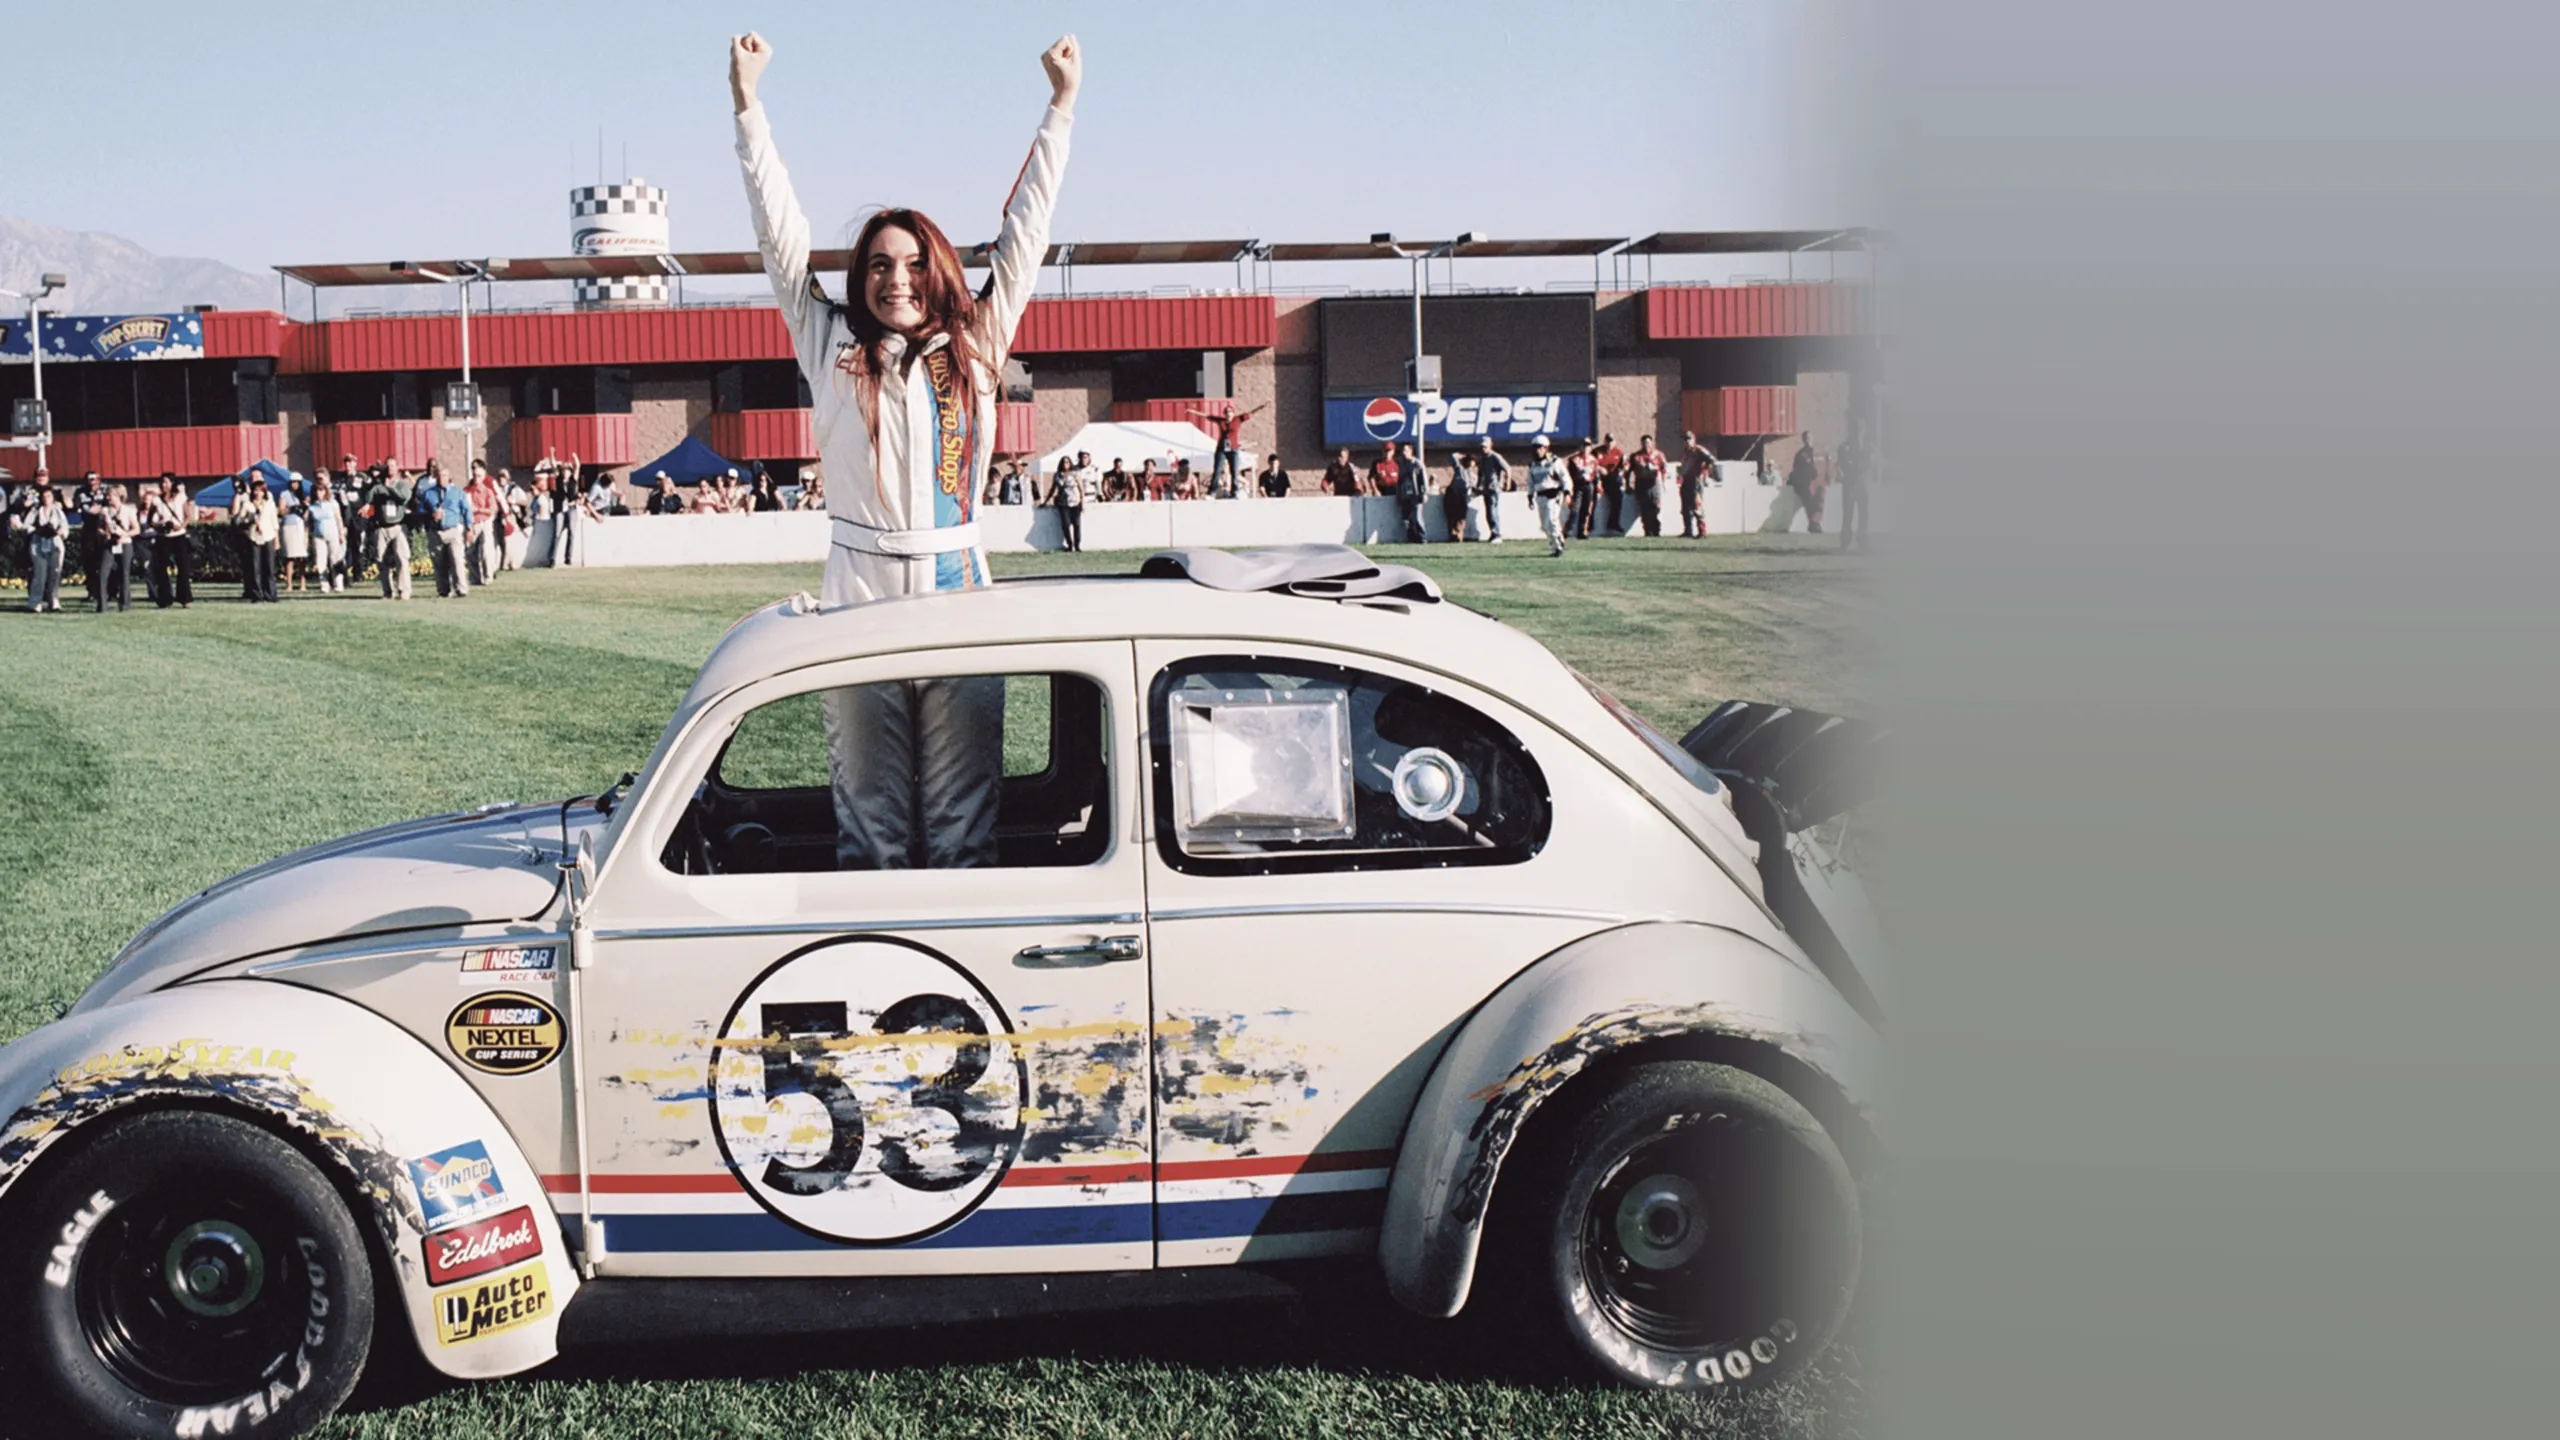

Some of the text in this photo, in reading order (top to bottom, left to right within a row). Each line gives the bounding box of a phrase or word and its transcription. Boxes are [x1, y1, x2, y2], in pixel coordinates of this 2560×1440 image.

[1410, 395, 1561, 436] PEPSI
[937, 432, 964, 494] Shops
[490, 949, 550, 969] NASCAR
[500, 971, 556, 981] RACE CAR
[488, 1008, 540, 1025] NASCAR
[467, 1028, 542, 1046] NEXTEL
[475, 1050, 539, 1060] CUP SERIES
[760, 992, 1001, 1197] 53
[427, 1160, 491, 1195] SUNOCO
[45, 1189, 116, 1287] EAGLE
[438, 1218, 532, 1270] Edelbrock
[474, 1274, 534, 1309] Auto
[470, 1289, 547, 1337] Meter
